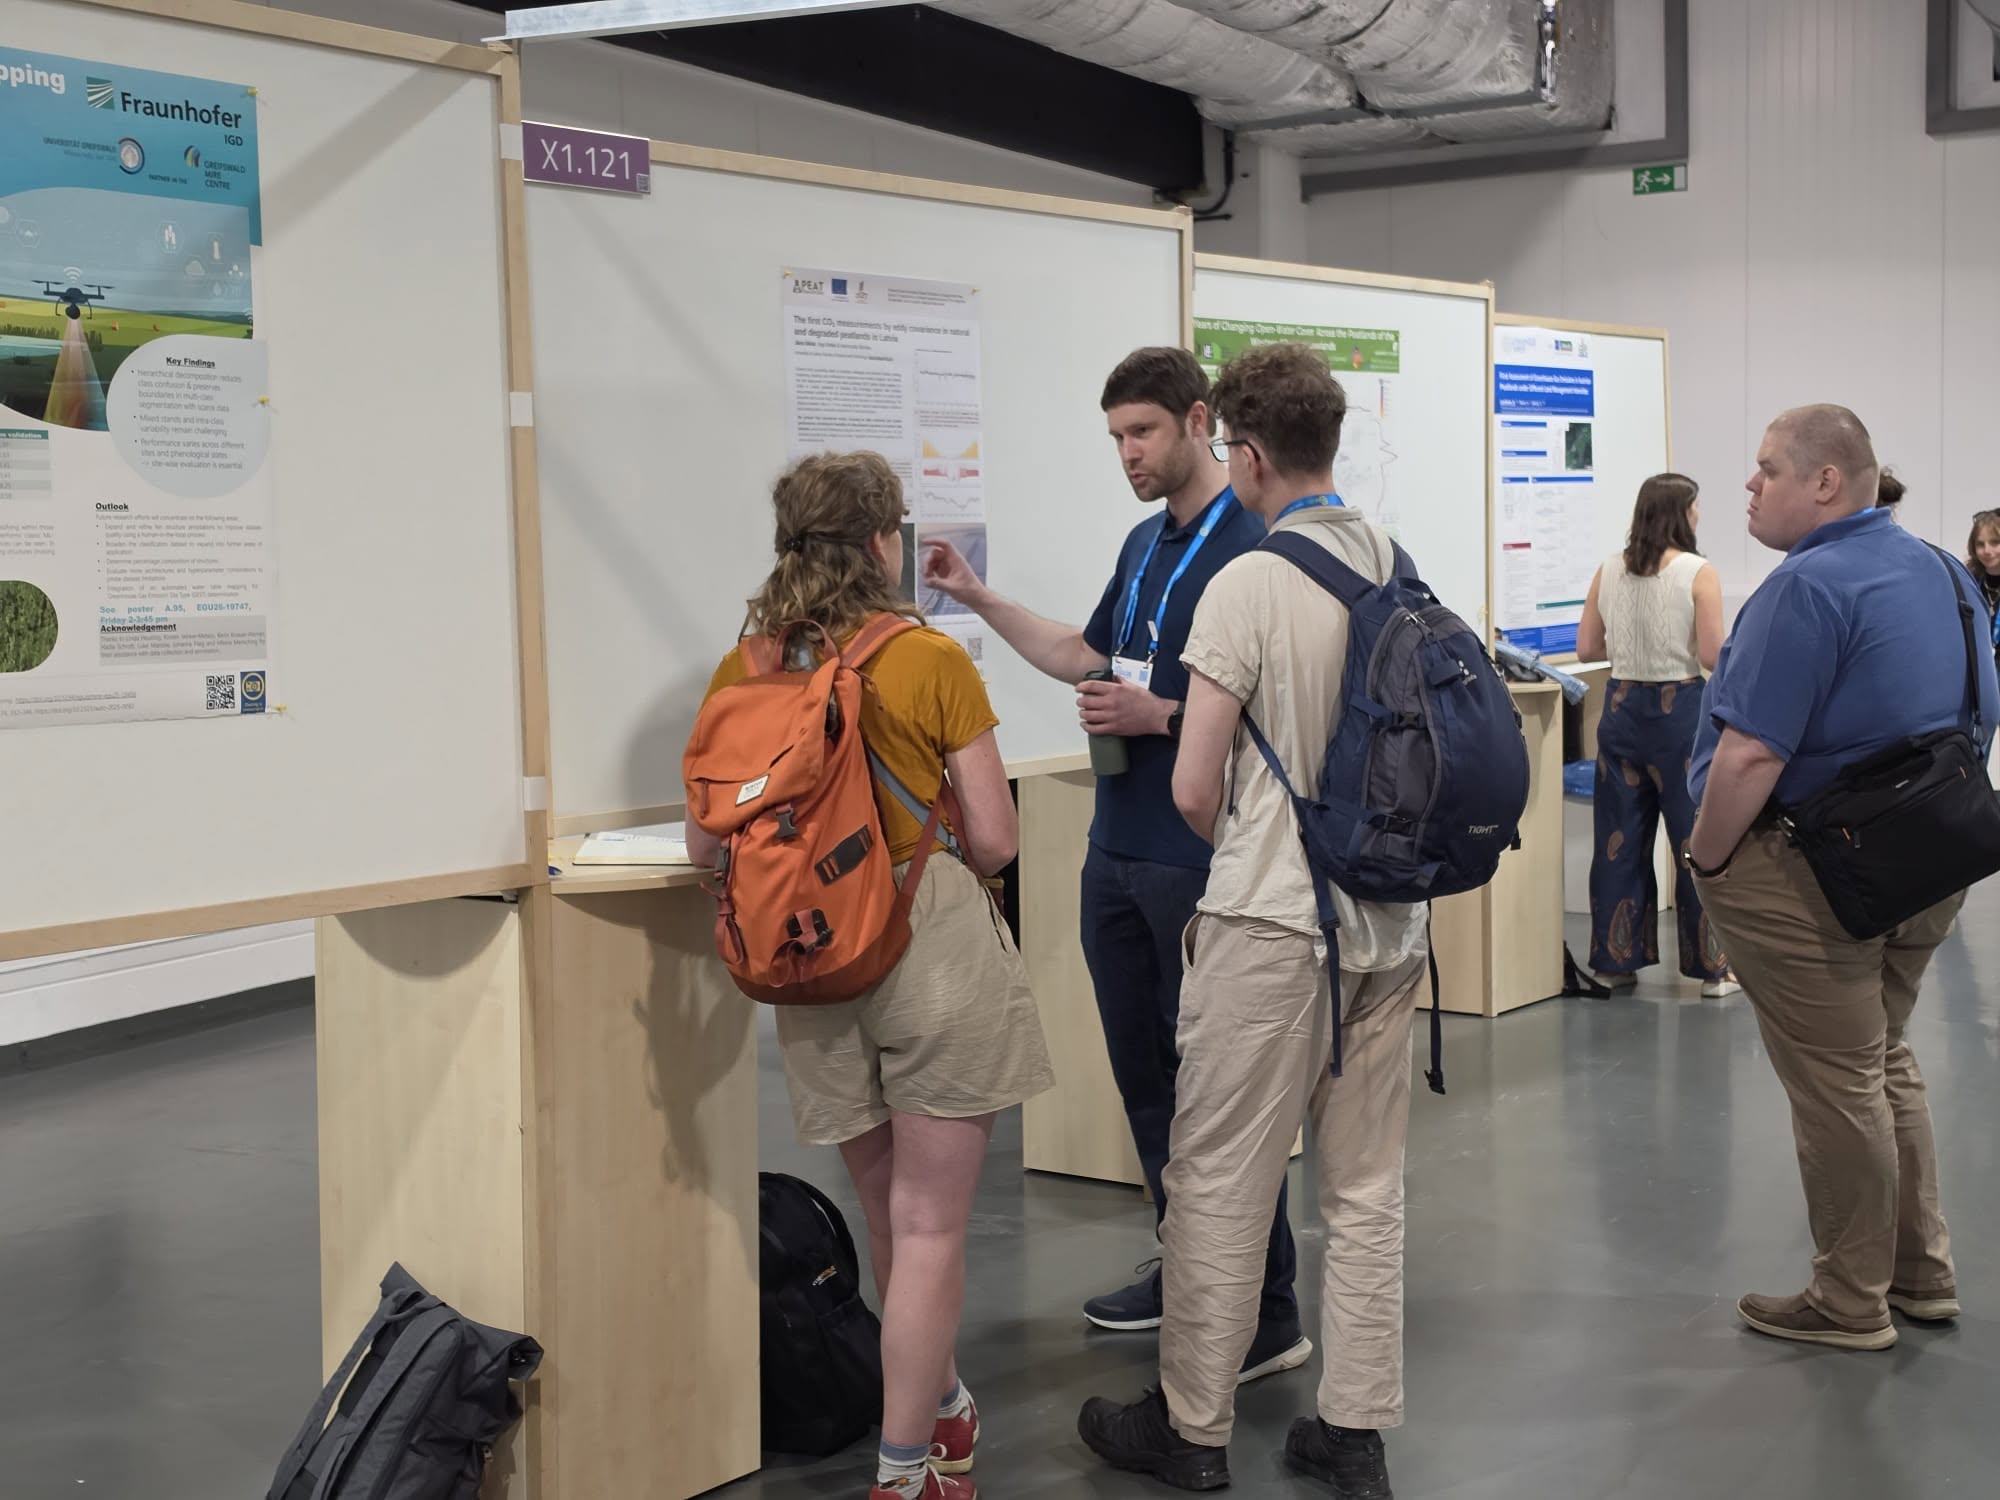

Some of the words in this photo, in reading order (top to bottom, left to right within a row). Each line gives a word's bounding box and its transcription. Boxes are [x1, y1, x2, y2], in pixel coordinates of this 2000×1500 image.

[121, 91, 242, 129] Fraunhofer
[224, 134, 244, 147] IGD
[540, 138, 630, 180] X1.121
[204, 160, 245, 174] GREIFSWALD
[204, 171, 222, 180] MIRE
[205, 180, 231, 190] CENTRE
[1222, 322, 1255, 334] Changing
[166, 357, 182, 366] Key
[184, 358, 216, 369] Findings
[140, 415, 160, 423] Mixed
[96, 502, 129, 512] Outlook
[100, 606, 116, 614] See
[128, 606, 153, 614] poster
[100, 617, 126, 625] Friday
[155, 616, 168, 624] pm
[100, 624, 177, 633] Acknowledgement
